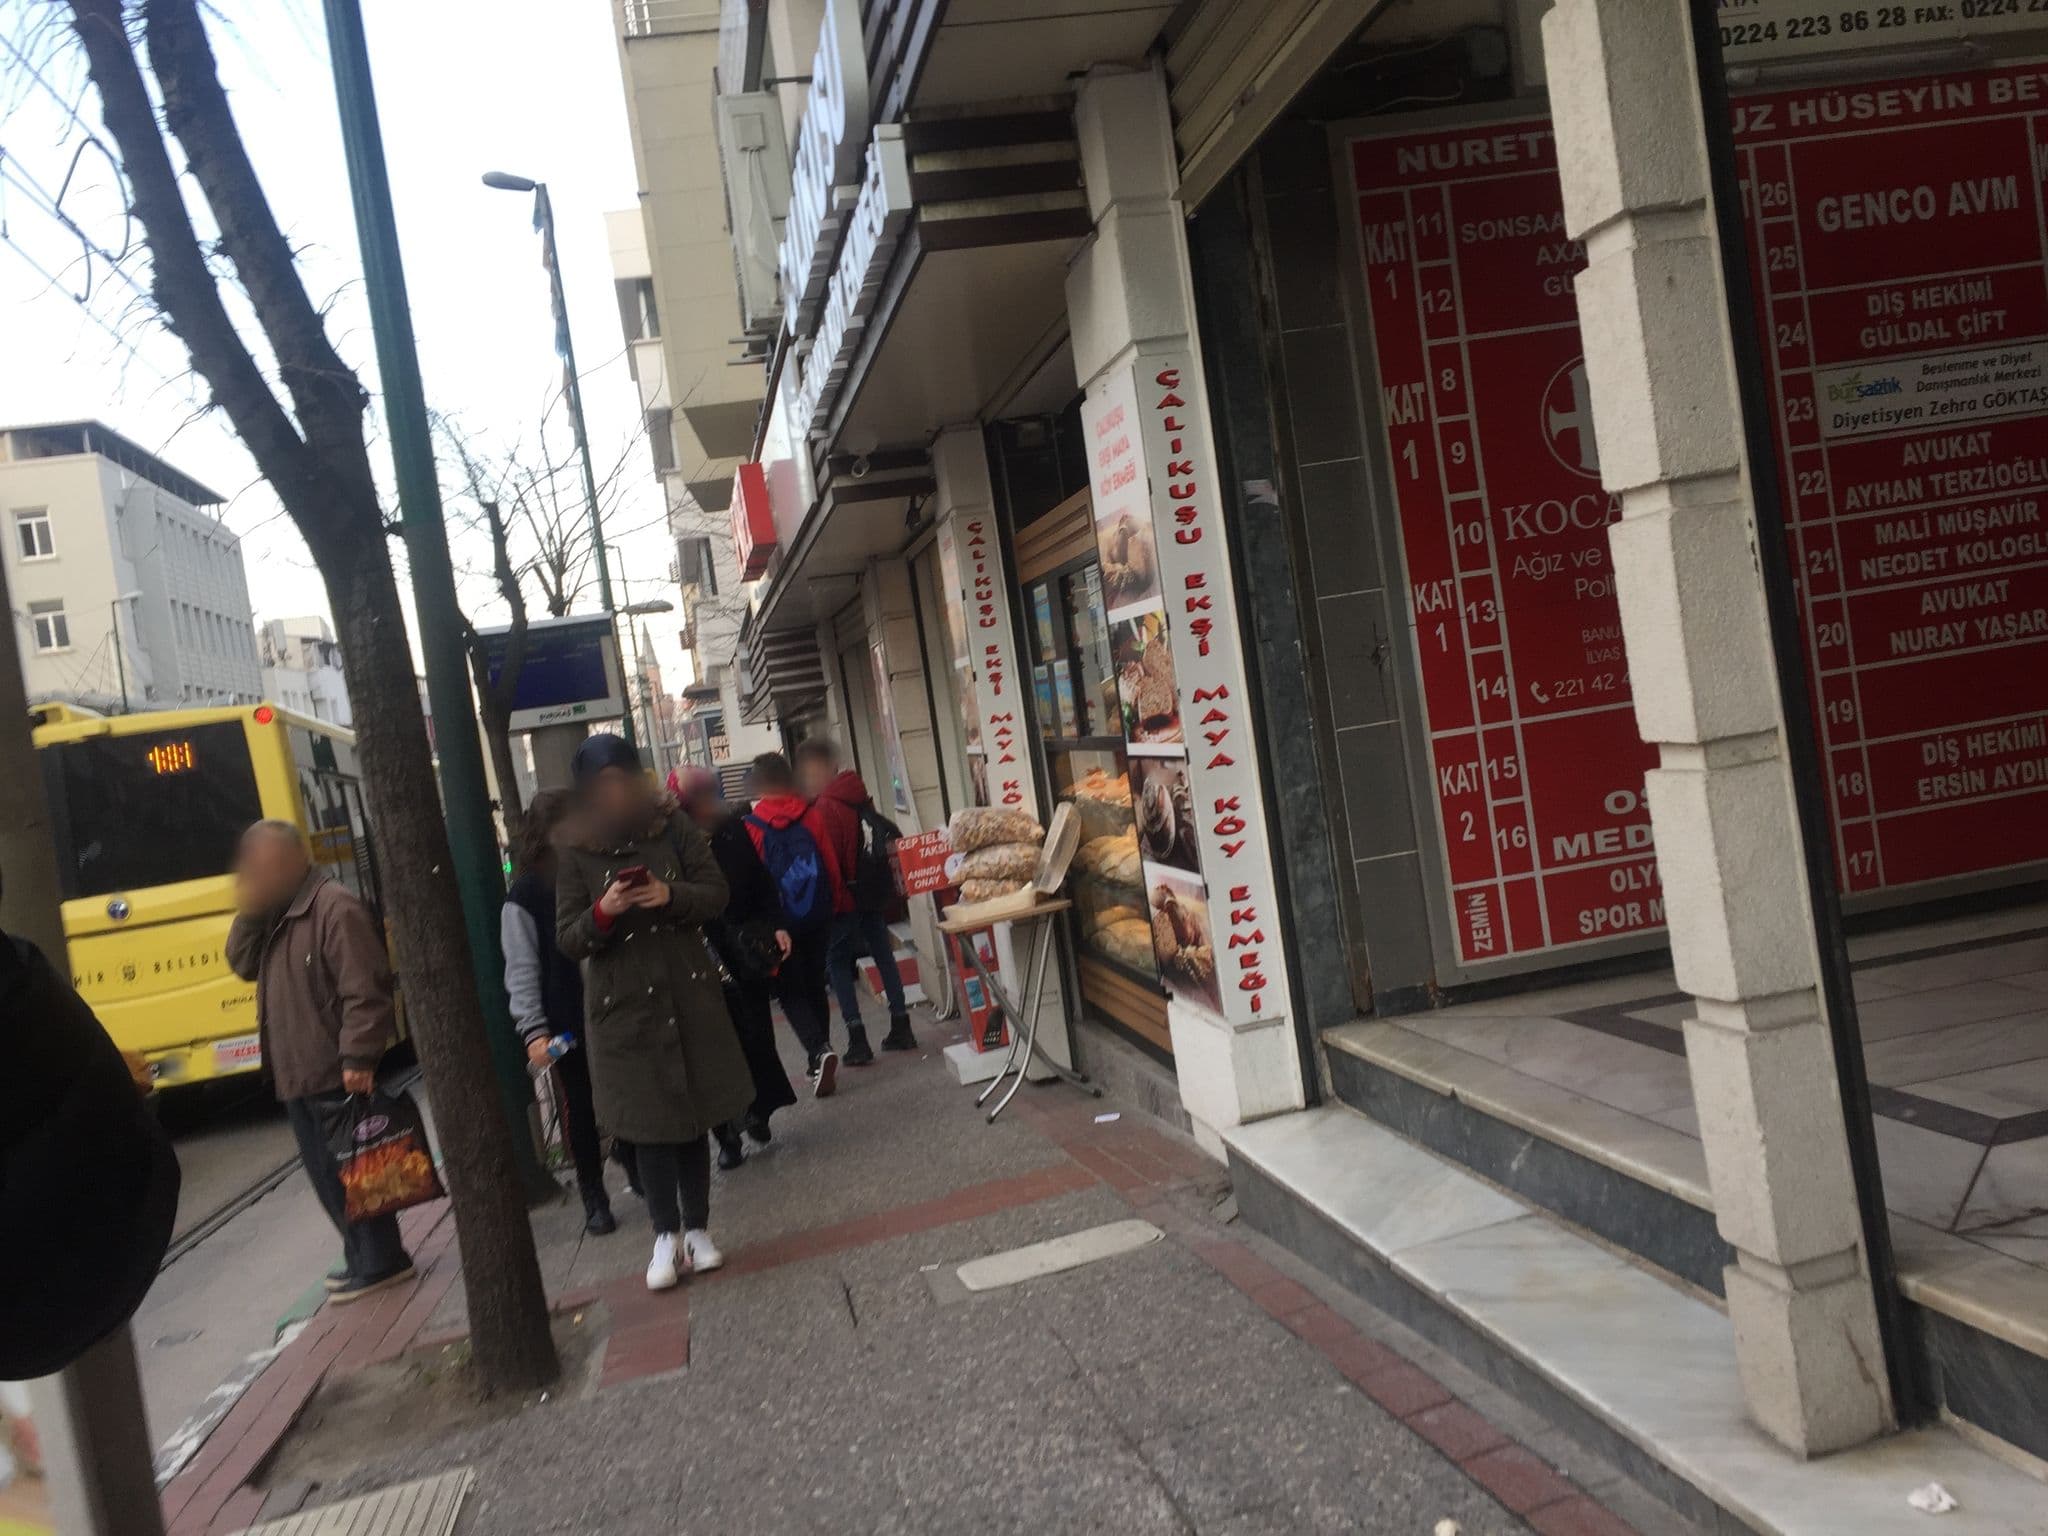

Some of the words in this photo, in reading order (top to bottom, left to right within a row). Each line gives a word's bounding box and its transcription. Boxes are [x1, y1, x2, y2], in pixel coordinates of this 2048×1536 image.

[1786, 15, 1832, 38] 223
[1840, 11, 1868, 32] 86
[1877, 6, 1906, 27] 28
[1915, 7, 1952, 23] FAX:
[1789, 80, 1974, 126] HÜSEYİN
[1396, 130, 1554, 175] NURET
[1761, 181, 1788, 207] 26
[1816, 185, 1937, 232] GENCO
[1948, 175, 2019, 217] AVM
[1416, 211, 1444, 237] 11
[1364, 220, 1408, 265] KAT
[1769, 246, 1797, 271] 25
[1385, 269, 1398, 300] 1
[1867, 290, 1905, 319] DİŞ
[1912, 274, 1994, 308] HEKİMİ
[1422, 289, 1454, 314] 12
[1778, 322, 1806, 348] 24
[1860, 318, 1951, 349] GÜLDAL
[1957, 308, 2008, 340] ÇİFT
[1917, 372, 1989, 393] Danışmanlık
[1995, 365, 2042, 382] Merkezi
[1922, 362, 1978, 376] Beslenme
[1983, 357, 1998, 367] ve
[2001, 351, 2032, 367] Diyet
[1441, 368, 1456, 392] 8
[1384, 382, 1425, 426] KAT
[1786, 398, 1815, 423] 23
[1833, 405, 1923, 430] Diyetisyen
[1930, 398, 1977, 416] Zehra
[1155, 368, 1202, 545] ÇALIKUŞU
[1403, 439, 1420, 480] 1
[1450, 441, 1467, 465] 9
[1904, 432, 1993, 466] AVUKAT
[1799, 470, 1826, 496] 22
[1846, 476, 1924, 510] AYHAN
[1453, 521, 1484, 546] 10
[1875, 512, 1932, 545] MALİ
[1937, 497, 2041, 537] MÜŞAVİR
[1512, 551, 1565, 581] Ağız
[1571, 548, 1602, 568] ve
[1808, 548, 1835, 574] 21
[1860, 547, 1949, 581] NECDET
[1414, 578, 1454, 614] KAT
[1466, 599, 1497, 624] 13
[1920, 579, 2010, 616] AVUKAT
[1185, 571, 1213, 657] EKŞİ
[1435, 622, 1448, 652] 1
[1817, 622, 1846, 648] 20
[1890, 620, 1968, 655] NURAY
[1476, 676, 1507, 701] 14
[1553, 678, 1585, 699] 221
[1591, 672, 1616, 692] 42
[1192, 683, 1235, 770] MAYA
[1828, 698, 1856, 725] 19
[989, 711, 1016, 765] MAYA
[1922, 734, 1961, 768] DİŞ
[1966, 717, 2047, 759] HEKİMİ
[1440, 761, 1480, 797] KAT
[1488, 755, 1519, 781] 15
[1917, 764, 1986, 801] ERSİN
[1993, 757, 2048, 788] AYDI
[1837, 771, 1865, 798] 18
[1213, 795, 1246, 858] KÖY
[1460, 811, 1476, 842] 2
[1497, 825, 1527, 850] 16
[897, 836, 919, 850] CEP
[908, 864, 941, 881] ANINDA
[1849, 850, 1875, 877] 17
[914, 875, 941, 890] ONAY
[1465, 891, 1493, 952] ZEMİN
[1578, 901, 1644, 935] SPOR
[1228, 884, 1268, 1013] EKMEĞİ
